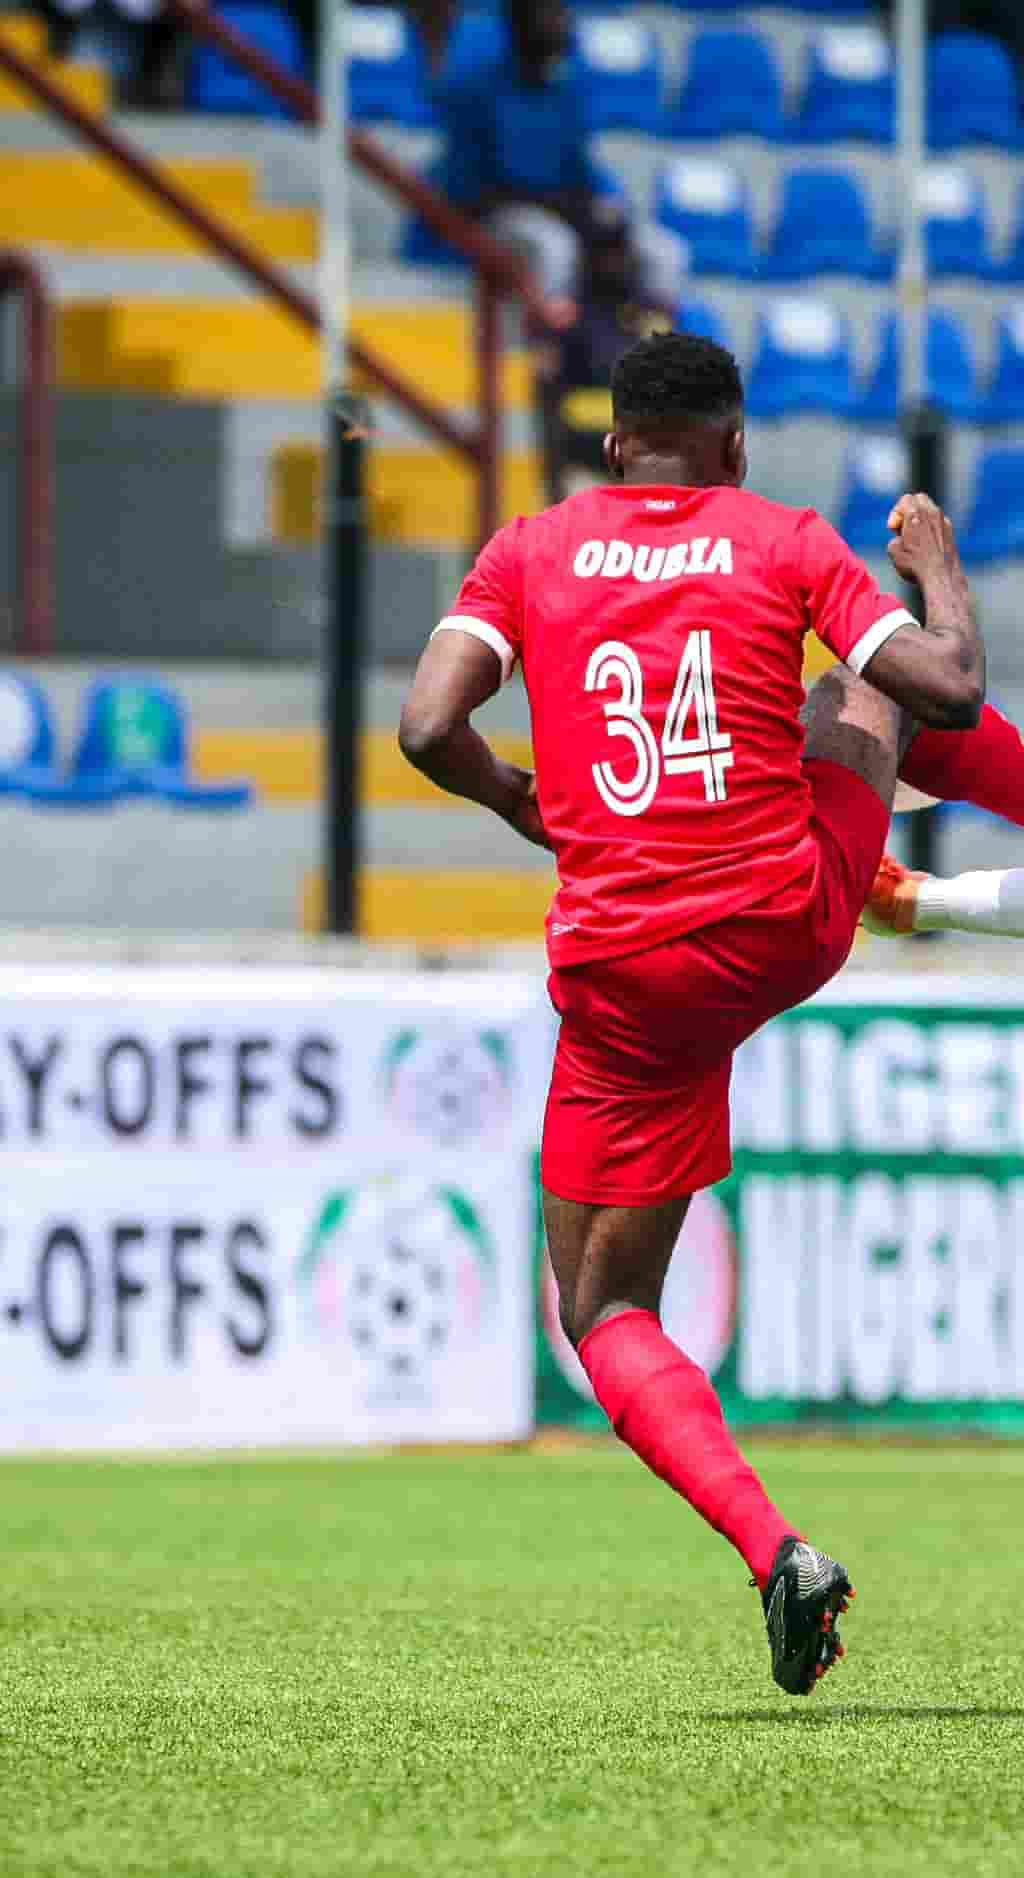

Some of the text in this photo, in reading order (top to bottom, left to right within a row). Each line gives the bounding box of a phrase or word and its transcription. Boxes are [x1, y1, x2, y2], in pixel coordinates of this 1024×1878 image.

[584, 629, 735, 817] 34
[0, 1032, 341, 1141] Y-OFFS
[0, 1220, 272, 1363] -OFFS
